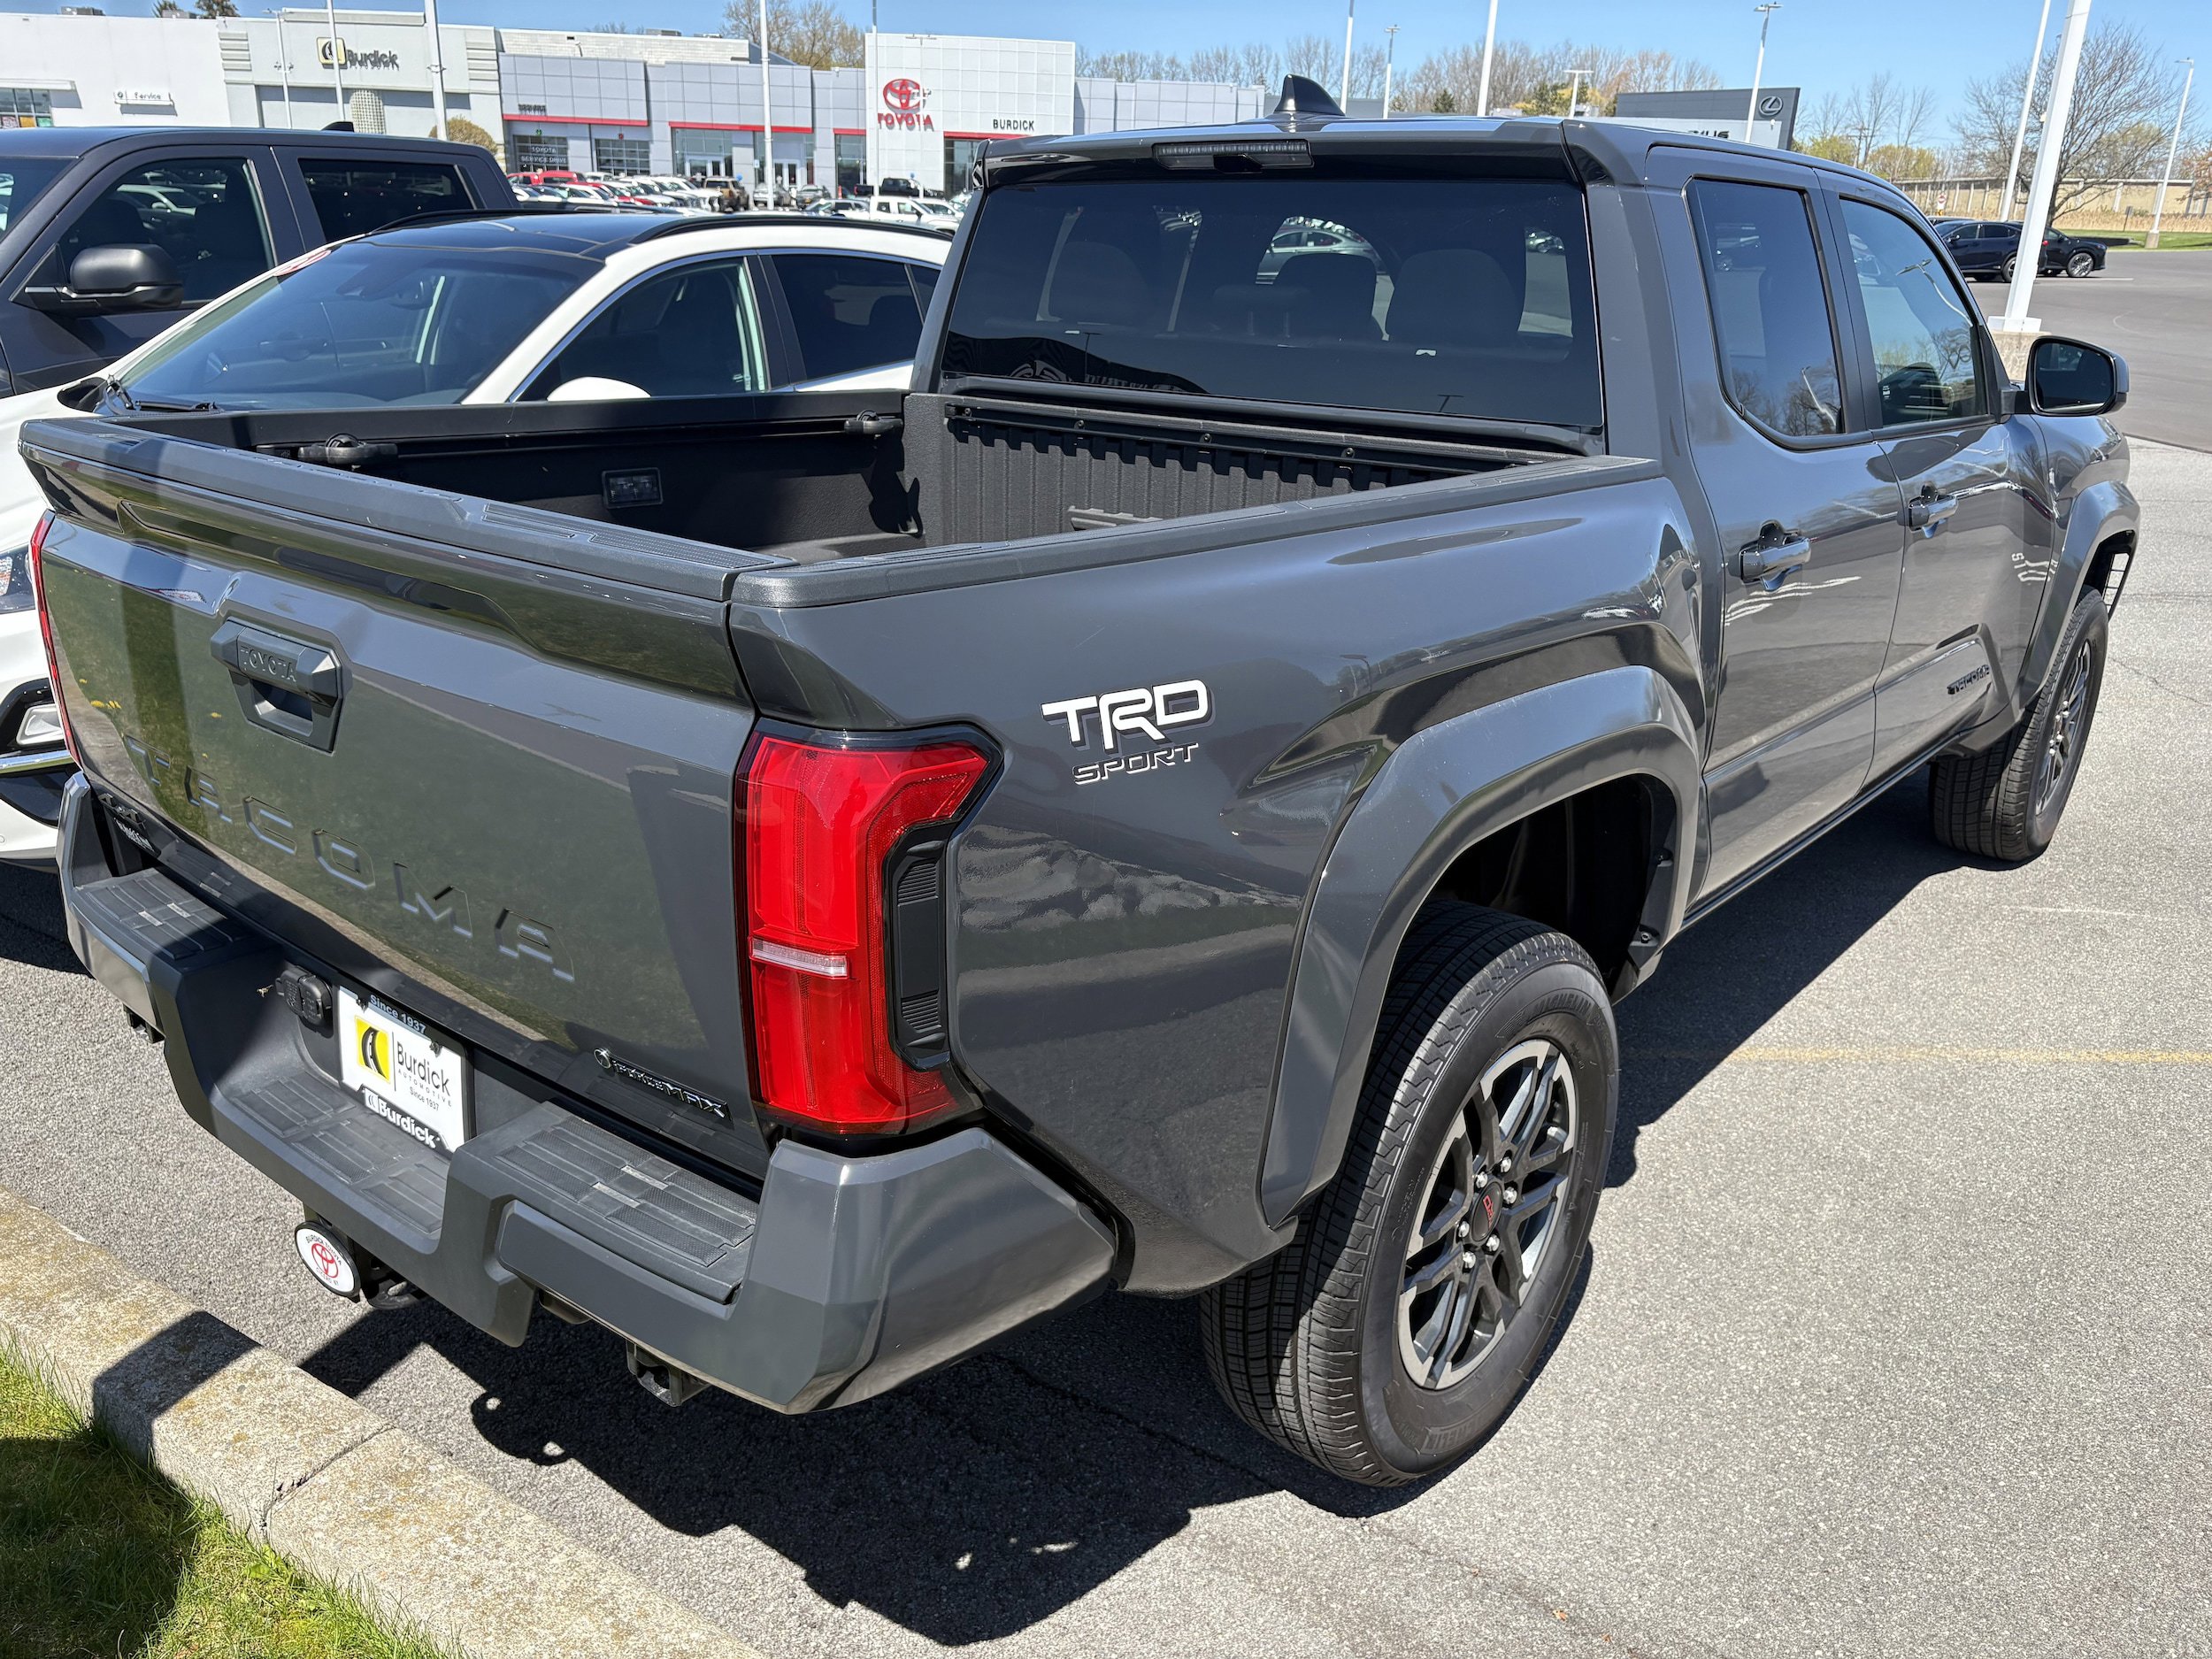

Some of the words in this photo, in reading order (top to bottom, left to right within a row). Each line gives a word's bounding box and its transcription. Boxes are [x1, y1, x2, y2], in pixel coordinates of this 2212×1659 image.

[347, 50, 399, 68] Burdick
[878, 112, 933, 128] TOYOTA
[993, 119, 1034, 131] BURDICK
[241, 645, 296, 682] TOYOTA
[1041, 679, 1211, 754] TRD
[1072, 742, 1199, 785] SPORT
[125, 734, 575, 982] TACOMA
[370, 994, 399, 1018] Since
[401, 1013, 426, 1034] 1937
[397, 1041, 450, 1097] Burdick
[398, 1069, 451, 1107] AUTOMOTIVE
[410, 1086, 425, 1103] Since
[379, 1098, 436, 1148] Burdick
